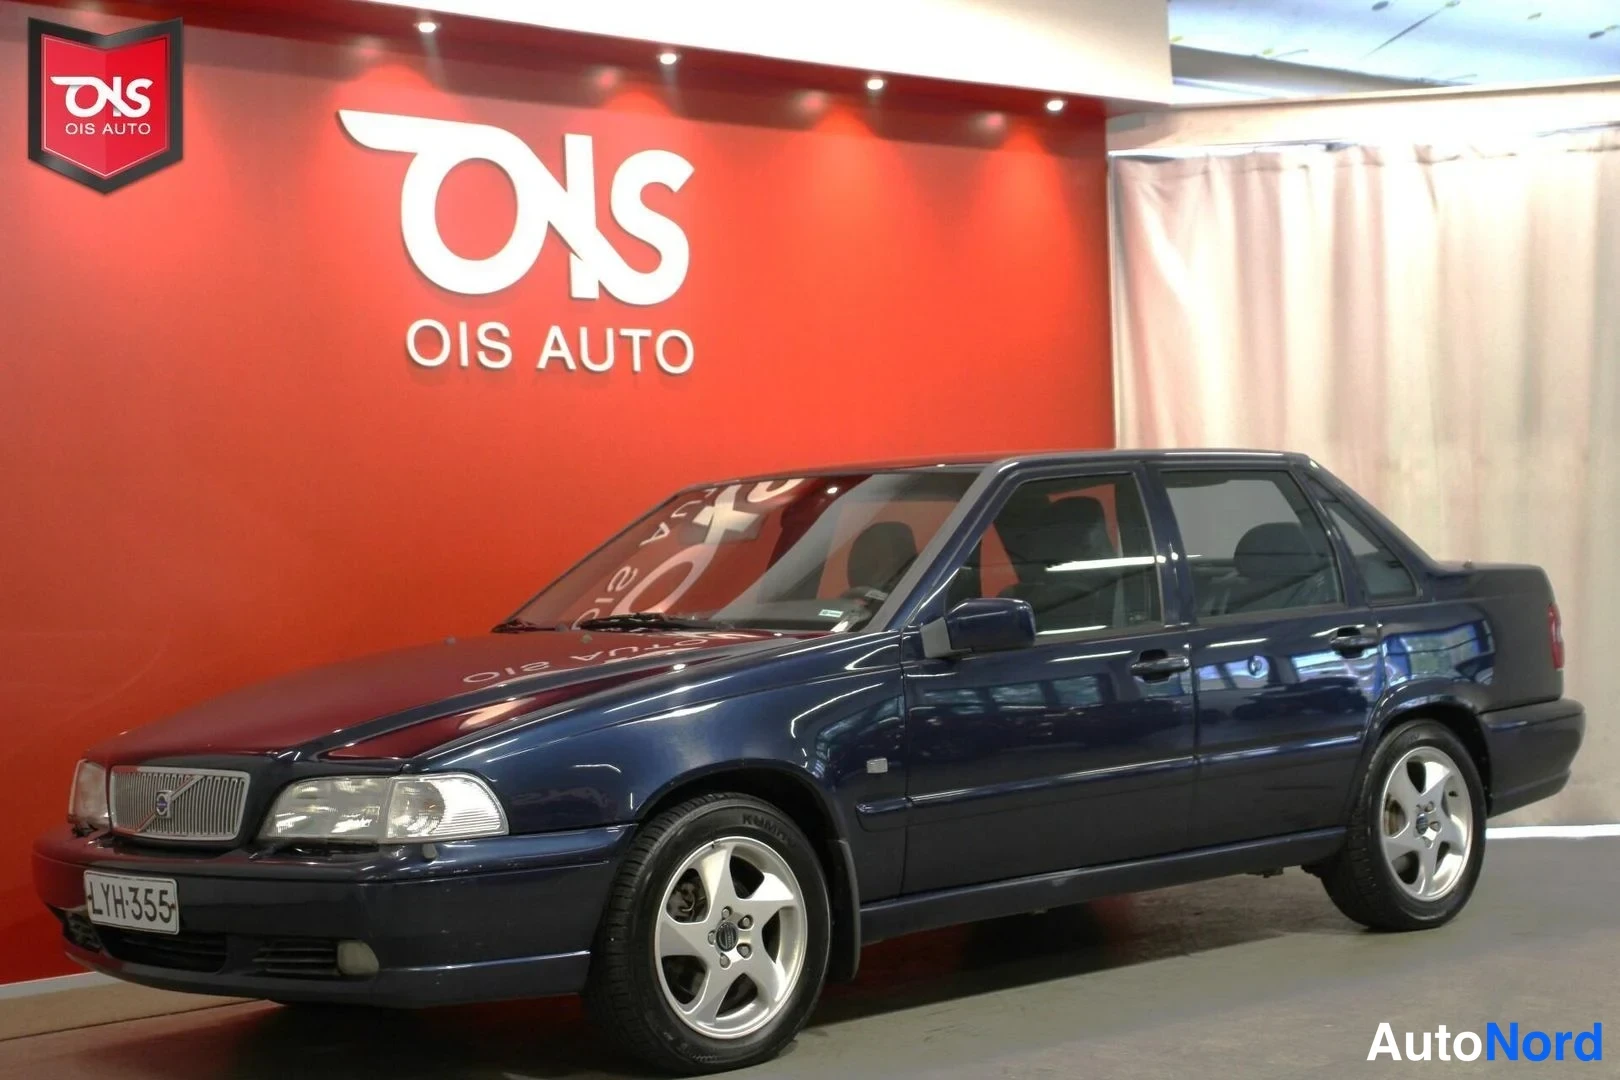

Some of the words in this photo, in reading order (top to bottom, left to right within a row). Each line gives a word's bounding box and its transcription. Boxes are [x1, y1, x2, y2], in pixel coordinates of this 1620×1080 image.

[338, 109, 695, 306] OIS
[406, 318, 513, 369] OIS
[536, 325, 695, 375] AUTO
[89, 881, 172, 923] LYH-355
